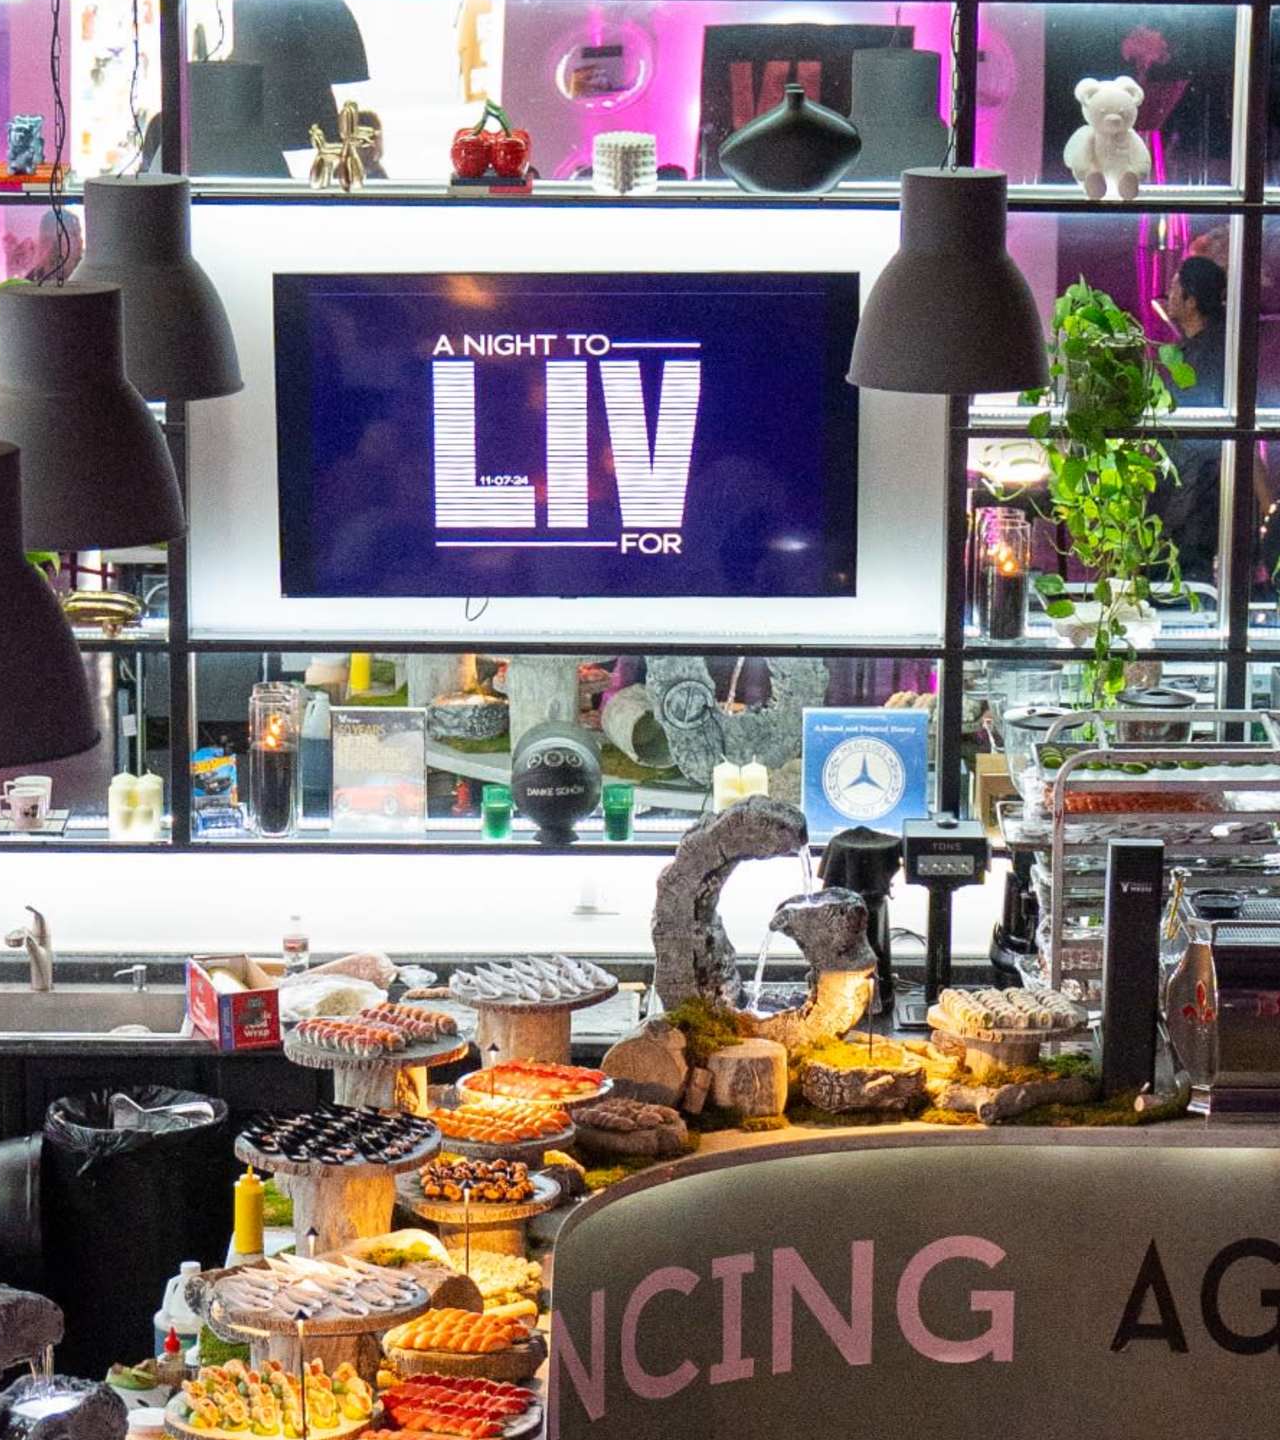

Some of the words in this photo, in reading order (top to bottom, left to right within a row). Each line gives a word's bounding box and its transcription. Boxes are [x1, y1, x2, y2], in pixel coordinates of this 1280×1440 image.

[432, 334, 454, 356] A
[463, 334, 558, 356] NIGHT
[566, 334, 611, 356] TO
[432, 360, 702, 529] LIV
[620, 532, 683, 555] FOR
